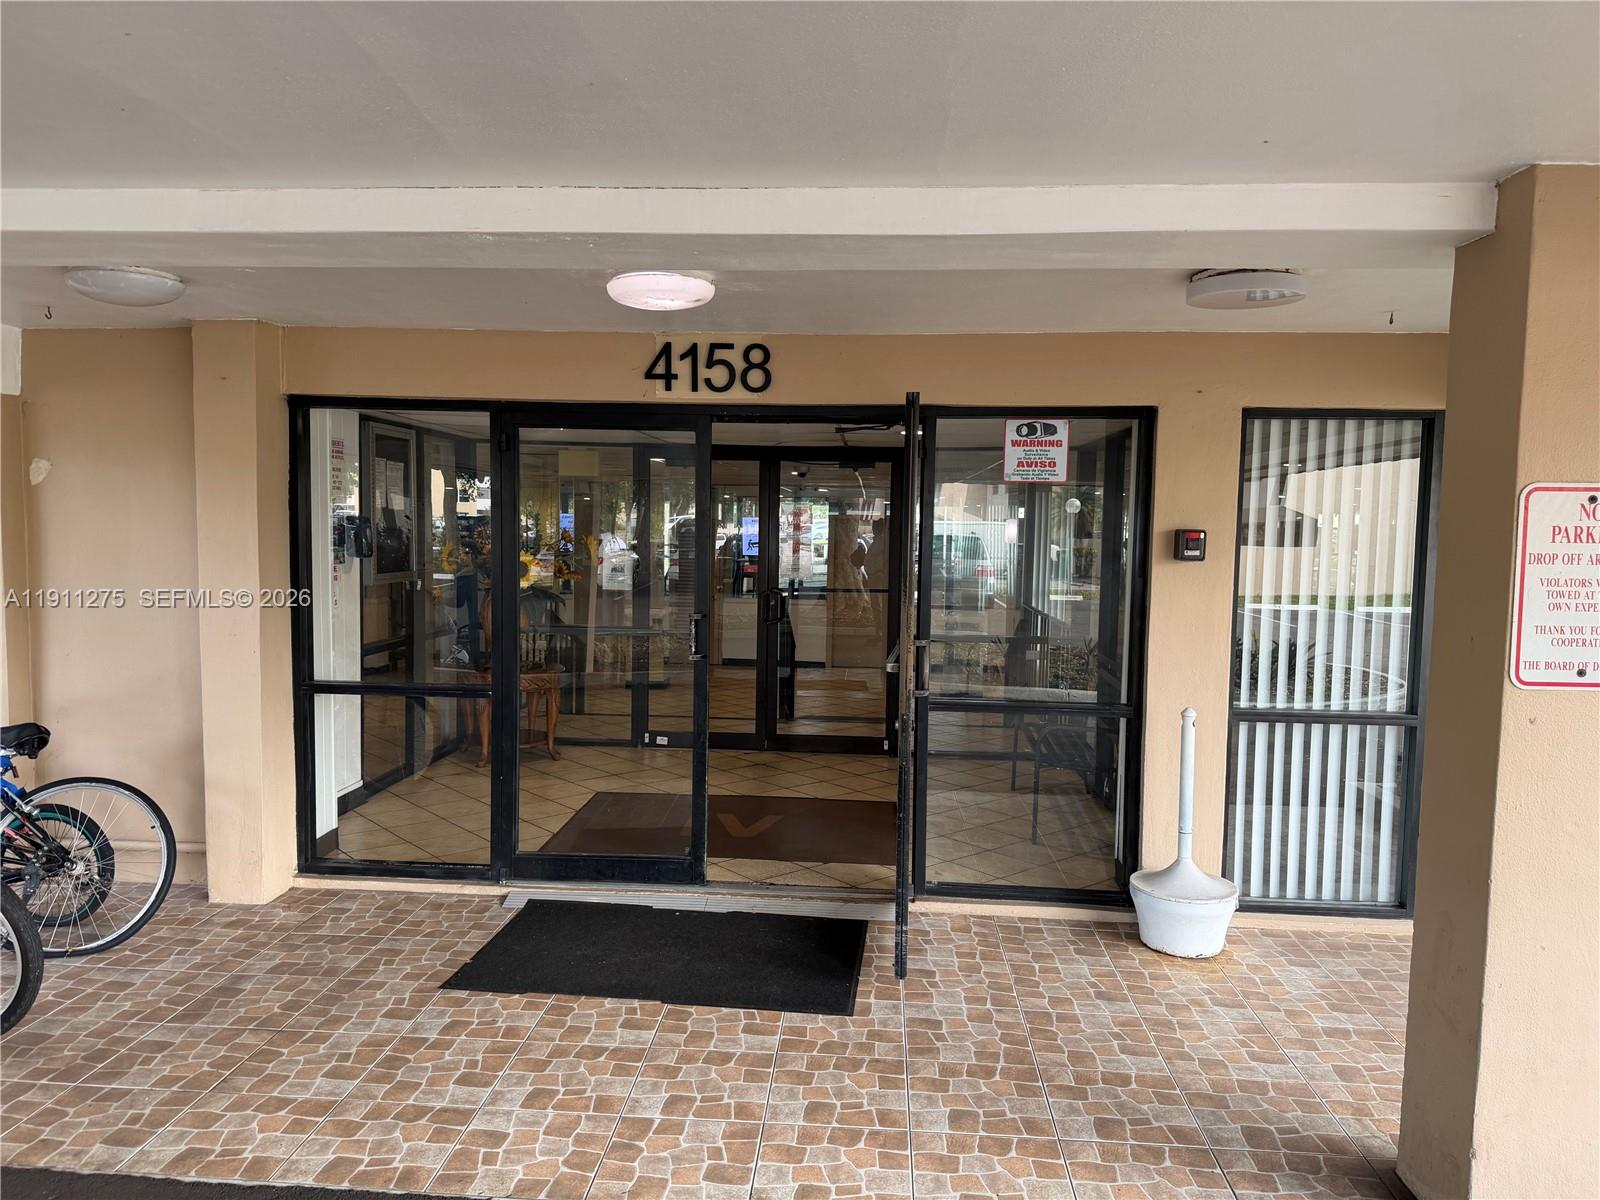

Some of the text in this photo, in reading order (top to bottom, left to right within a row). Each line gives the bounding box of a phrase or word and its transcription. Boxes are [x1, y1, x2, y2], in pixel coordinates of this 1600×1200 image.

[644, 341, 772, 393] 4158
[1011, 440, 1062, 448] WARNING
[1550, 525, 1600, 544] PARK
[1528, 552, 1559, 566] DROP
[1561, 553, 1584, 566] OFF
[1540, 577, 1593, 589] VIOLATORS
[1546, 590, 1596, 600] TOWED AT
[1548, 602, 1571, 612] OWN
[1534, 625, 1566, 635] THANK
[1569, 625, 1587, 636] YOU
[1551, 637, 1600, 648] COOPERAT
[1522, 660, 1541, 671] THE
[1544, 661, 1575, 671] BOARD
[1577, 661, 1591, 671] OF
